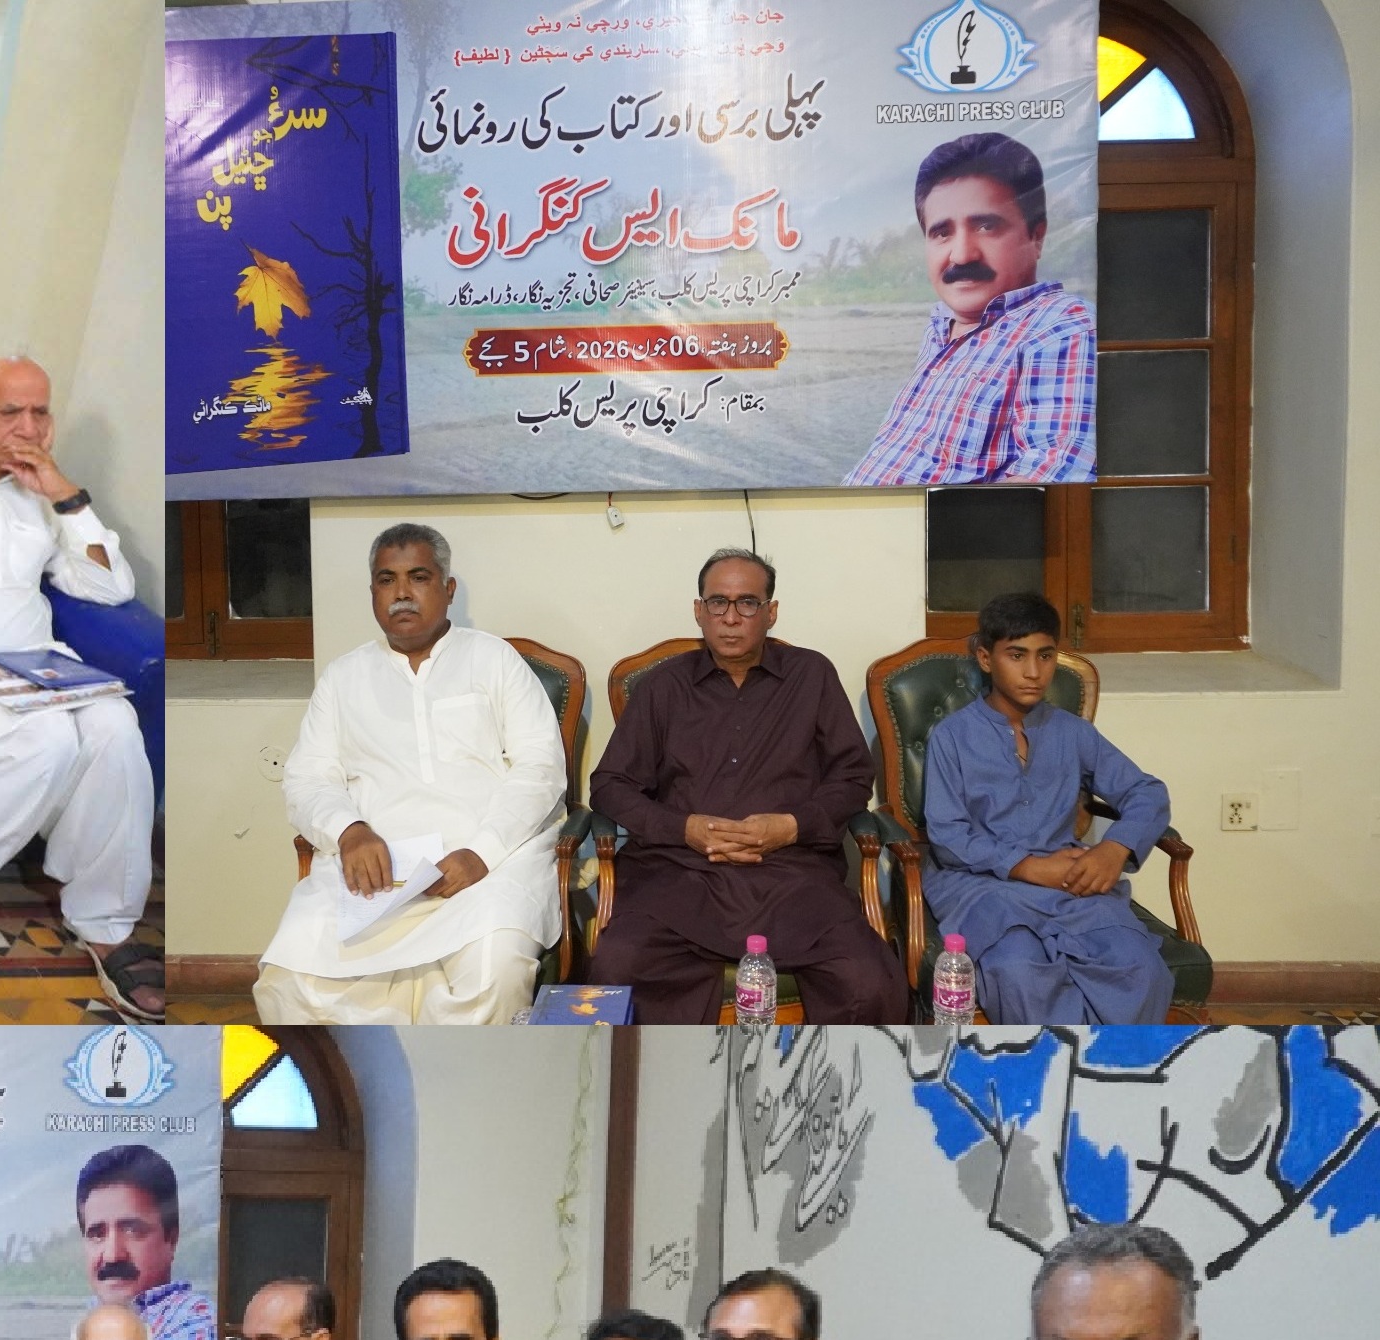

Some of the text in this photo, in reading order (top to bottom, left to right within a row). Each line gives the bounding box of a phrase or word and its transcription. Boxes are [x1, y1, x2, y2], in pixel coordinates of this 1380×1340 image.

[419, 73, 825, 154] پہلی برسی اور کتاب کی رونمائی
[877, 100, 1065, 123] KARACHI PRESS CLUB
[196, 189, 233, 231] پن
[447, 177, 610, 266] کنگرانی
[582, 187, 680, 263] ایس
[447, 281, 474, 306] نگار
[470, 283, 512, 306] ڈرامہ
[541, 271, 577, 311] تجزیہ
[692, 271, 731, 308] پریس
[733, 268, 783, 306] کراچی
[771, 271, 801, 303] ممبر
[477, 336, 509, 368] بجے
[514, 341, 530, 362] 5
[534, 334, 568, 370] شام
[631, 337, 668, 361] جون
[670, 334, 698, 355] 06
[738, 335, 772, 357] بروز
[517, 379, 581, 434] کلب
[573, 379, 637, 436] پریس
[642, 375, 724, 434] کراچی
[45, 1113, 197, 1134] KARACHI PRESS CLUB
